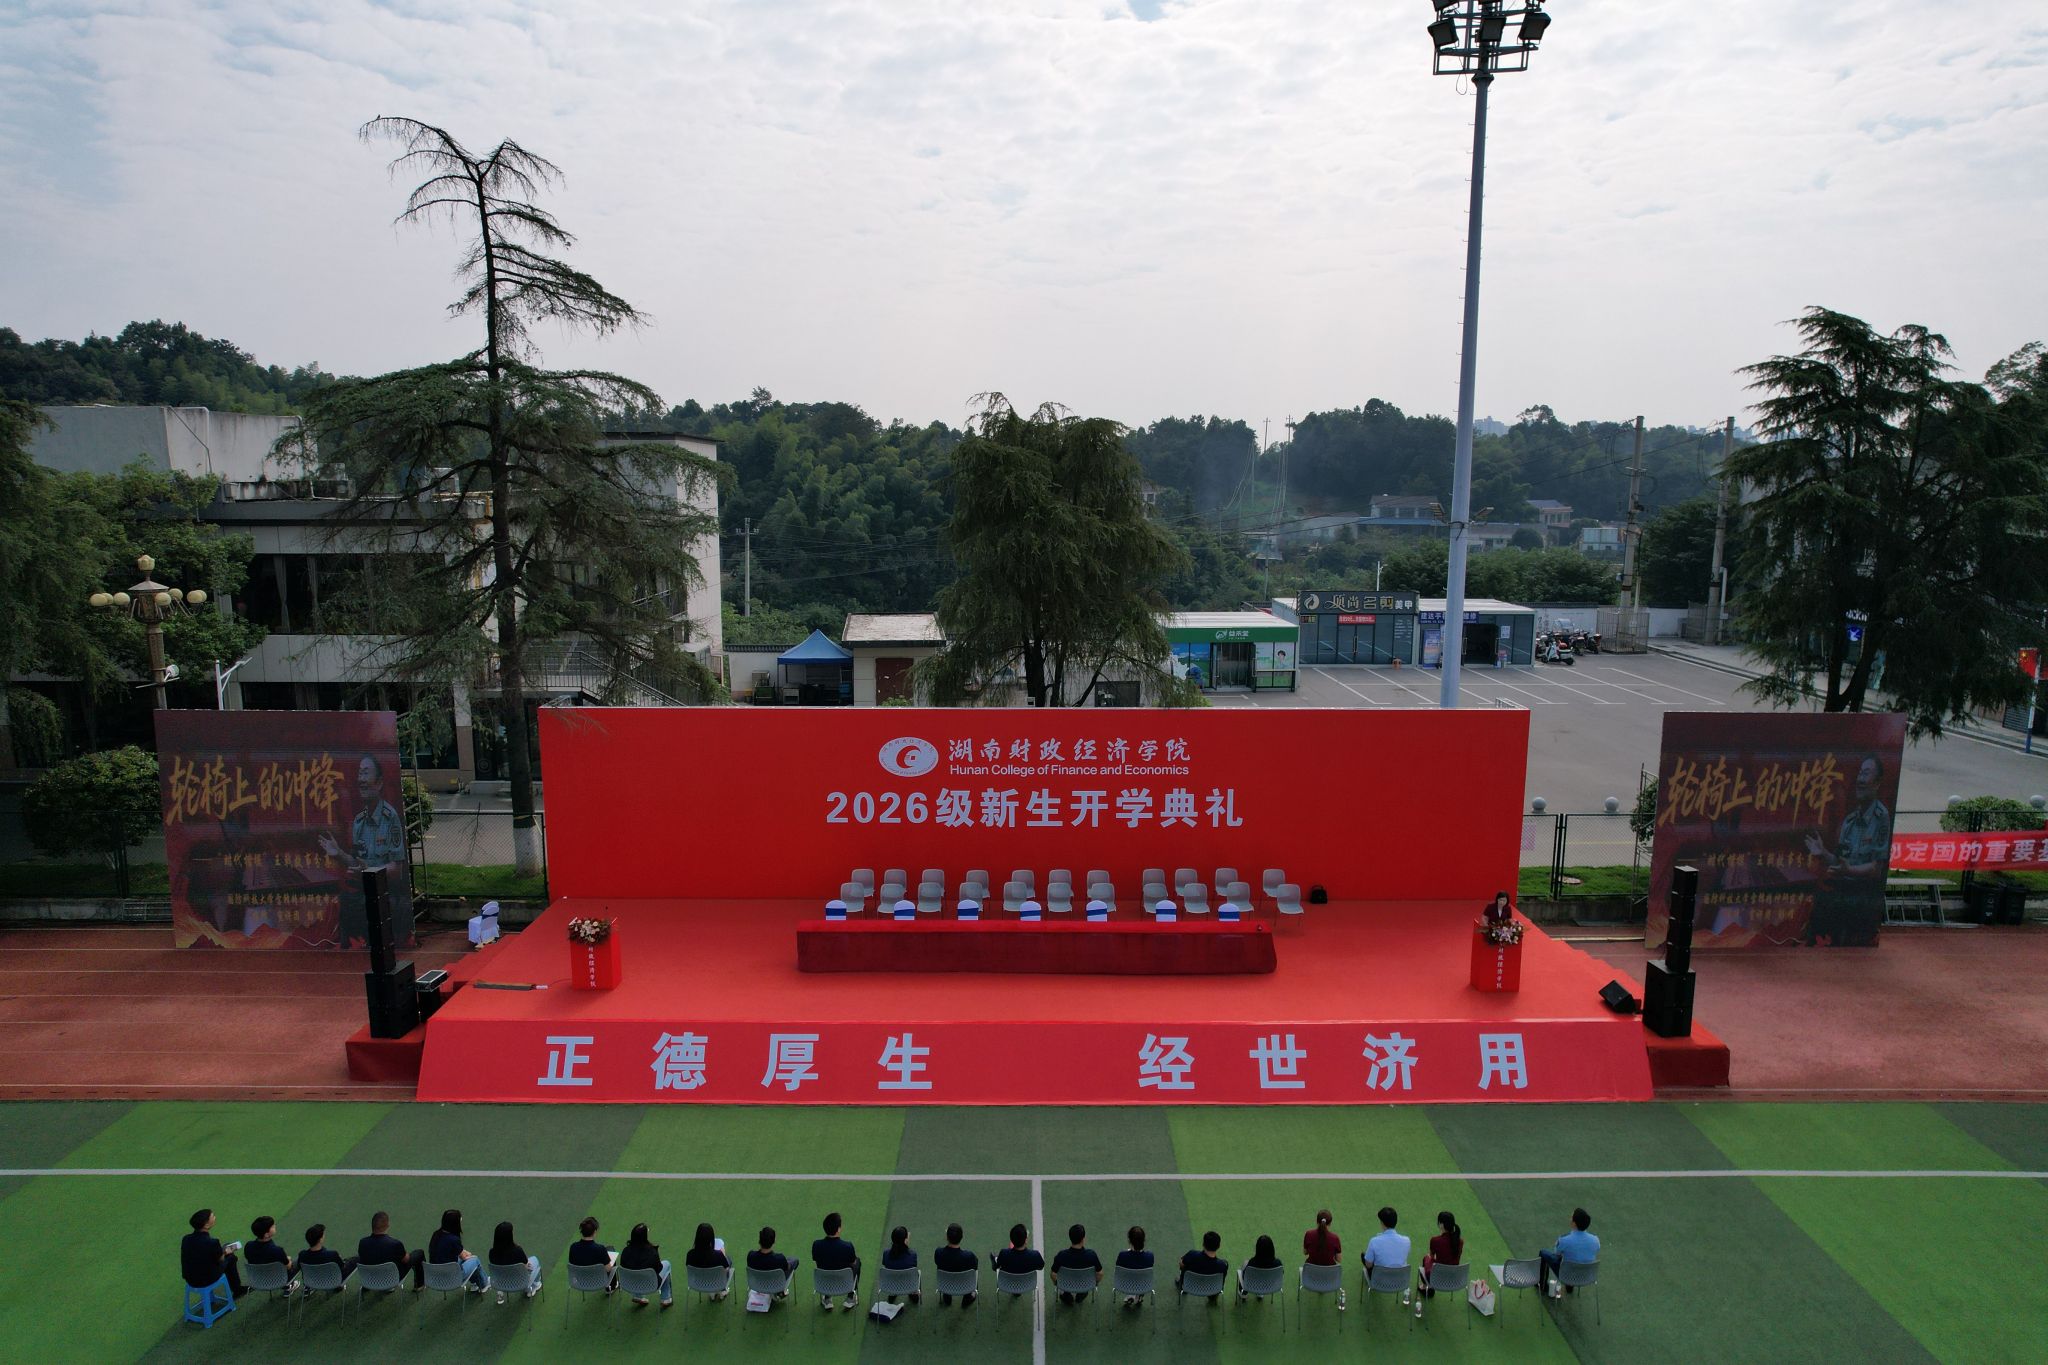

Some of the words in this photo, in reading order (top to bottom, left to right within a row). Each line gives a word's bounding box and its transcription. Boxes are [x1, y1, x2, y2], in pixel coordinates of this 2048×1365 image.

[948, 738, 1191, 763] 湖南财政经济学院
[951, 764, 988, 775] Hunan
[992, 764, 1034, 778] College
[1037, 764, 1049, 775] of
[1051, 764, 1098, 775] Finance
[1100, 764, 1122, 775] and
[1124, 764, 1190, 775] Economics
[166, 752, 345, 826] 轮椅上的冲锋
[827, 788, 1243, 828] 2026级新生开学典礼
[1658, 752, 1844, 826] 轮椅上的冲锋
[537, 1032, 933, 1092] 正德厚生
[1138, 1032, 1529, 1092] 经世济用
